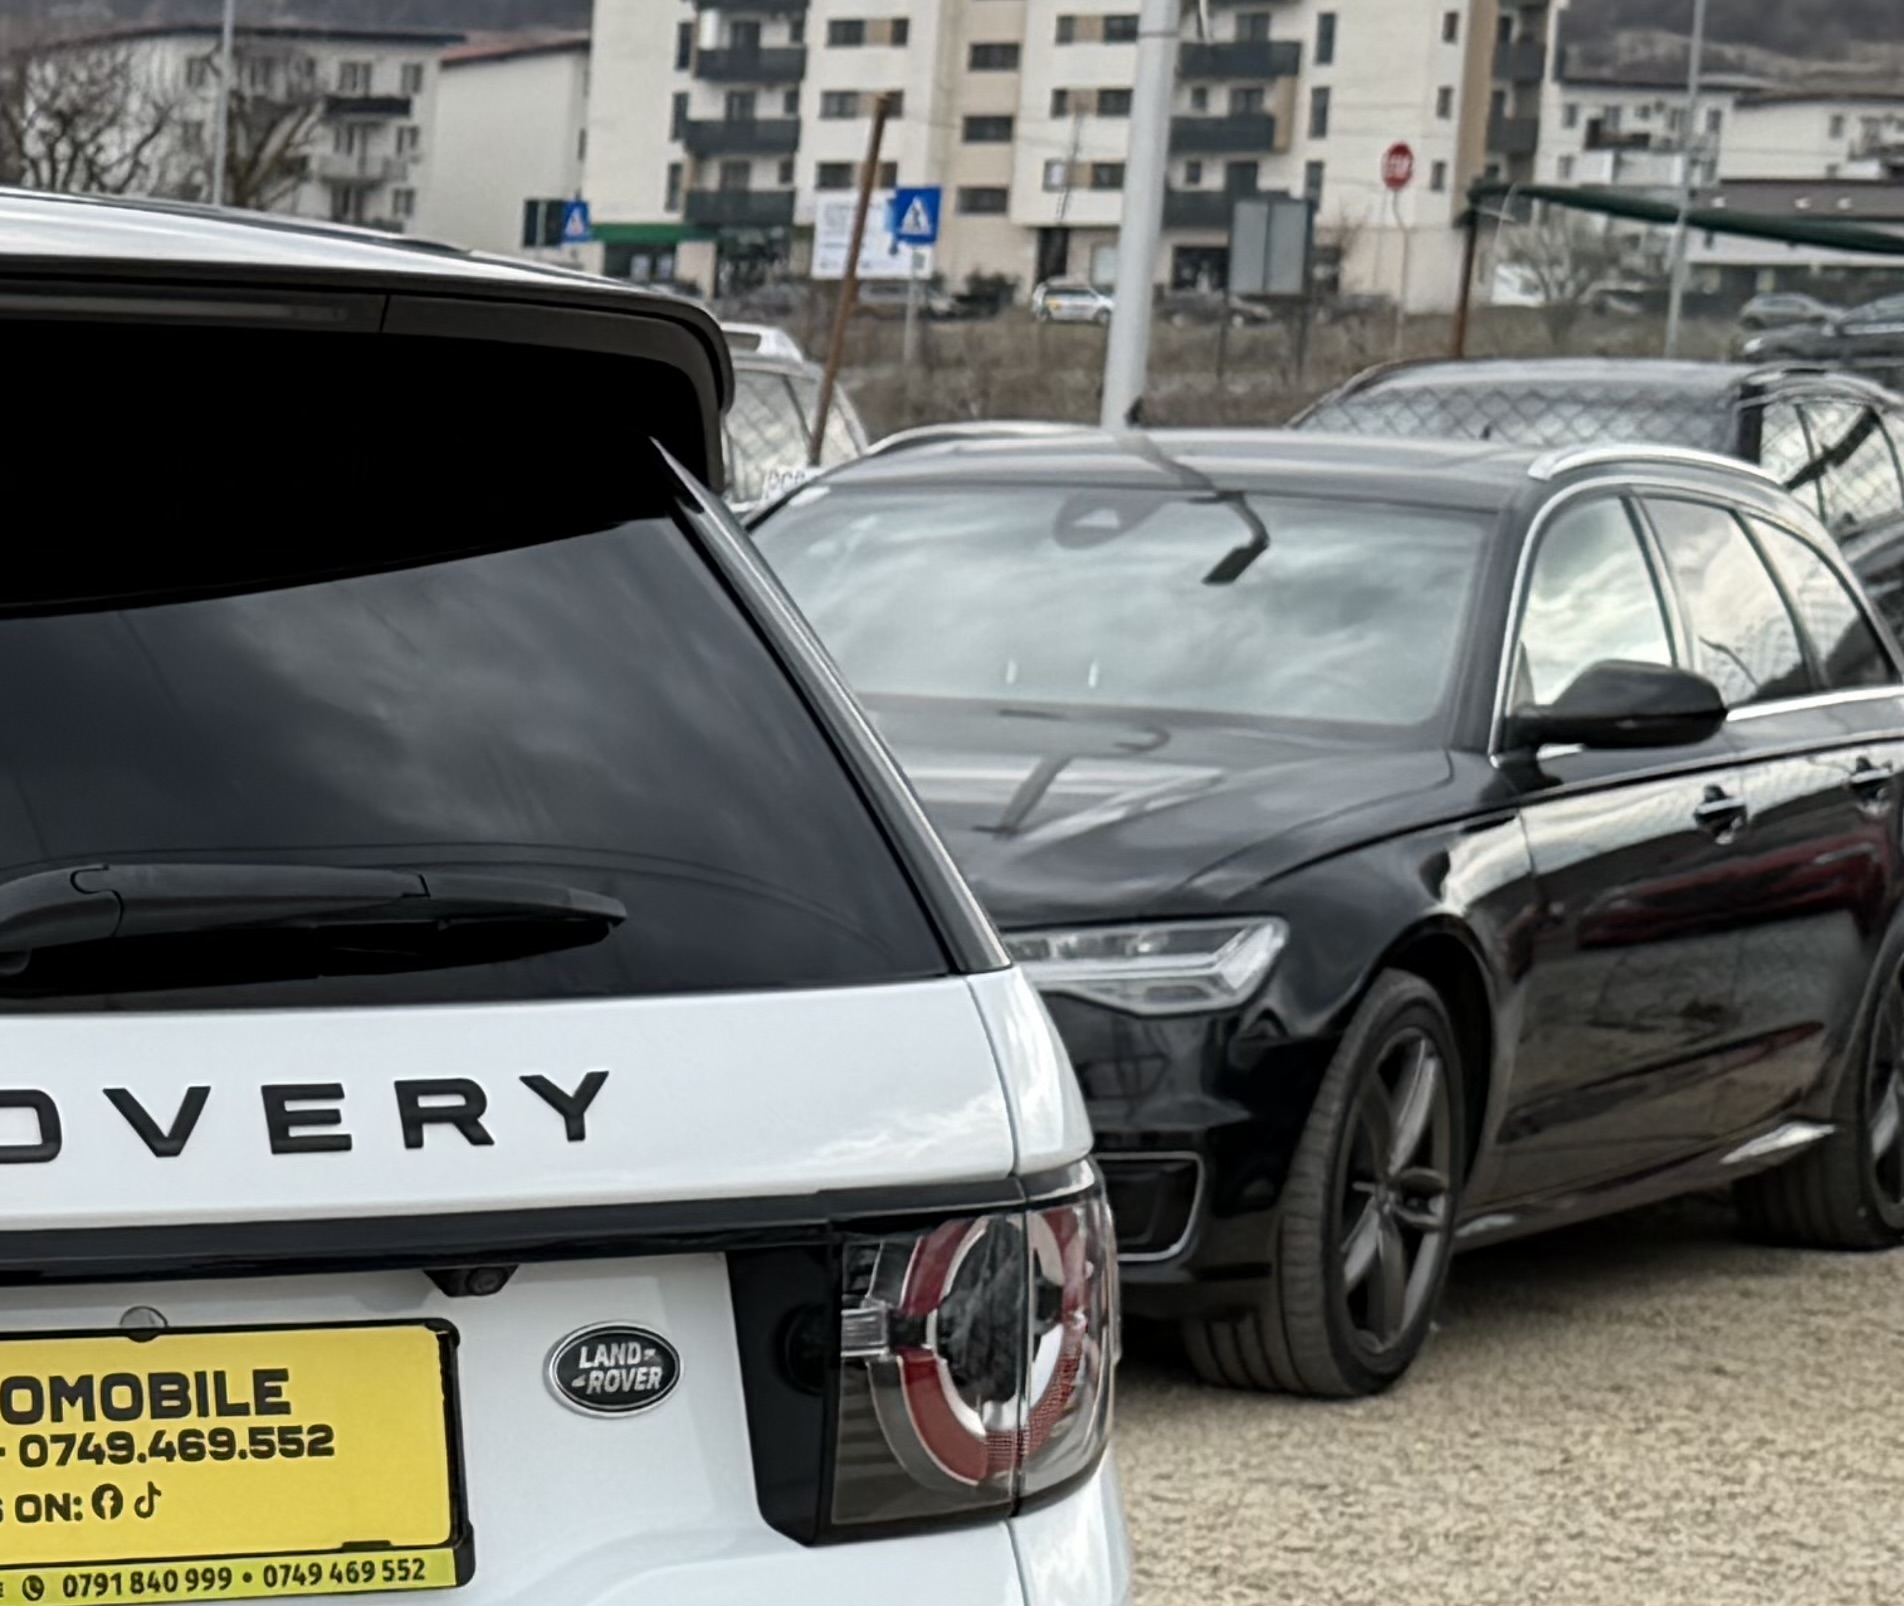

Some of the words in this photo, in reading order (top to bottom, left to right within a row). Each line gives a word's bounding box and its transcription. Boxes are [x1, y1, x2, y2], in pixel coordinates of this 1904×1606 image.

[579, 1342, 641, 1369] LAND
[586, 1366, 663, 1395] ROVER
[19, 1424, 335, 1467] 0749.469.552
[15, 1492, 84, 1523] ON:
[63, 1572, 124, 1599] 0791
[130, 1569, 178, 1594] 840
[185, 1566, 233, 1591] 999
[263, 1562, 323, 1588] 0749
[329, 1560, 376, 1585] 469
[382, 1557, 426, 1582] 552
